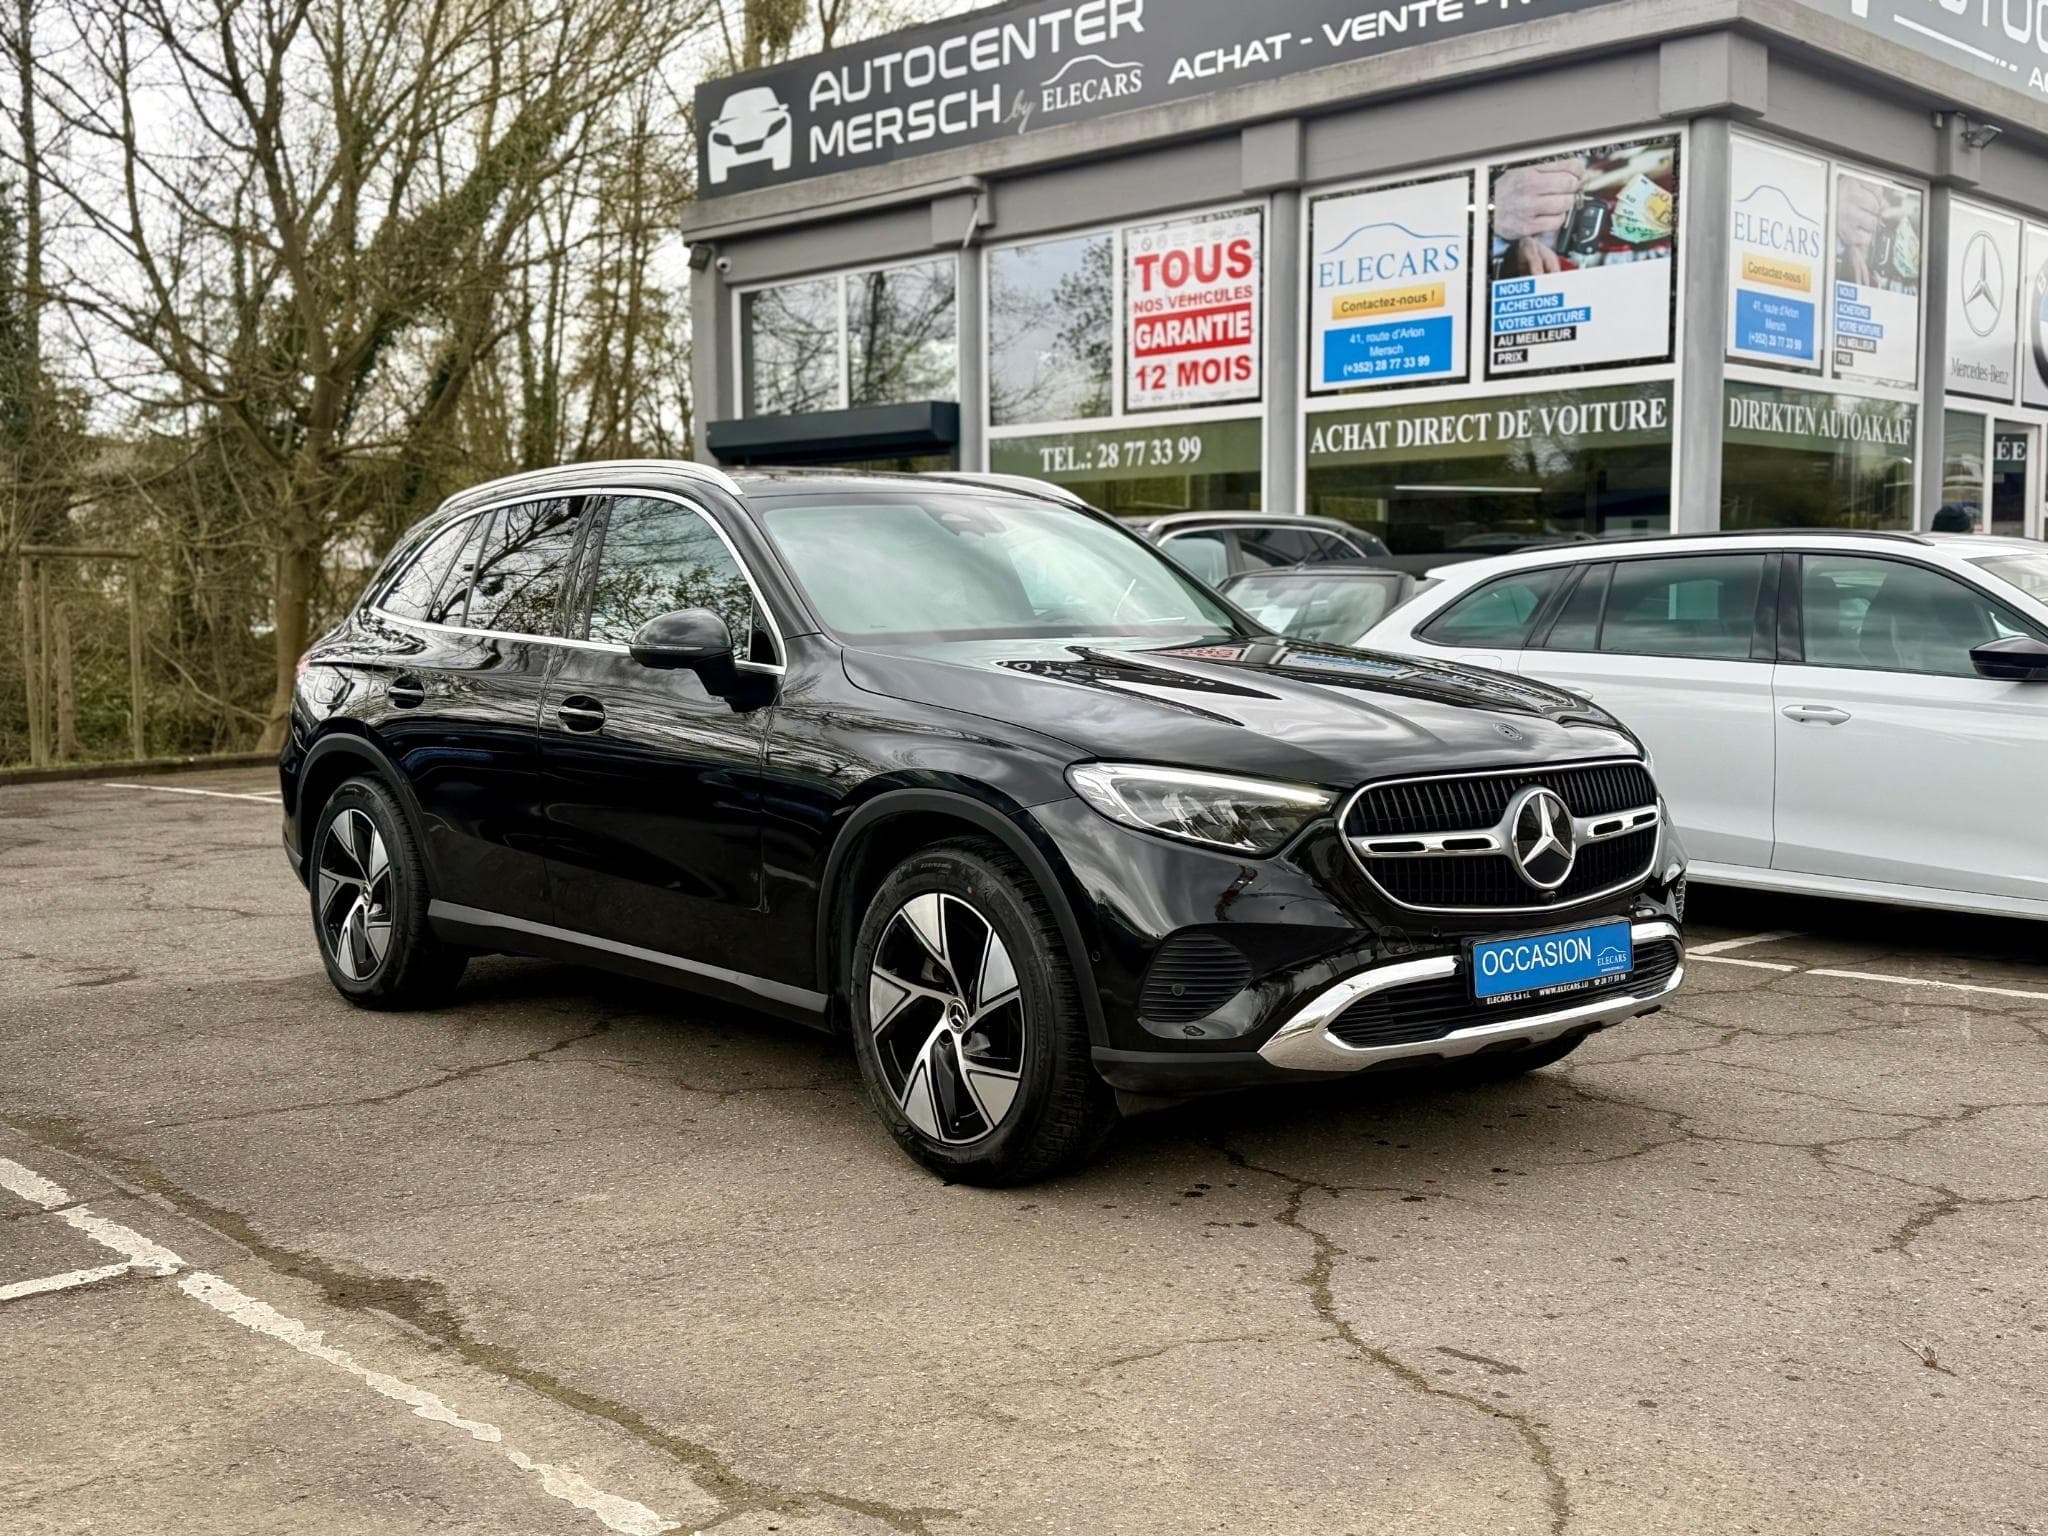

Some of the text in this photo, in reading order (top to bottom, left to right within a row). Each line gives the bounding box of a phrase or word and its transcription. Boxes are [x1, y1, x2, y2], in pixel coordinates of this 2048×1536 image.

[809, 0, 1144, 112] AUTOCENTER
[1167, 33, 1292, 85] ACHAT
[1322, 0, 1464, 47] VENTE
[809, 69, 1143, 163] MERSCH by ELECARS
[1734, 211, 1820, 258] ELECARS
[1135, 239, 1253, 292] TOUS
[1318, 244, 1460, 288] ELECARS
[1340, 292, 1428, 313] Contactez-nous
[1499, 282, 1530, 295] NOUS
[1134, 299, 1163, 314] NOS
[1499, 296, 1559, 313] ACHETONS
[1135, 310, 1250, 351] GARANTIE
[1498, 309, 1586, 330] VOTRE VOITURE
[1349, 332, 1365, 345] 41,
[1366, 331, 1390, 343] route
[1369, 344, 1404, 357] Mersch
[1498, 329, 1571, 347] AU MEILLEUR
[1343, 355, 1431, 376] (+352) 28 77 33 99
[1498, 351, 1523, 364] PRIX
[1950, 356, 2009, 385] Mercedes-Benz
[1135, 354, 1253, 391] 12 MOIS
[1310, 398, 1667, 453] ACHAT DIRECT DE VOITURE
[1729, 397, 1913, 445] DIREKTEN AUTOAKAAF
[1039, 436, 1202, 473] TEL.: 28 77 33 99
[1482, 936, 1592, 976] OCCASION
[1597, 952, 1627, 967] ELECARS
[1487, 993, 1512, 1005] ELECARS
